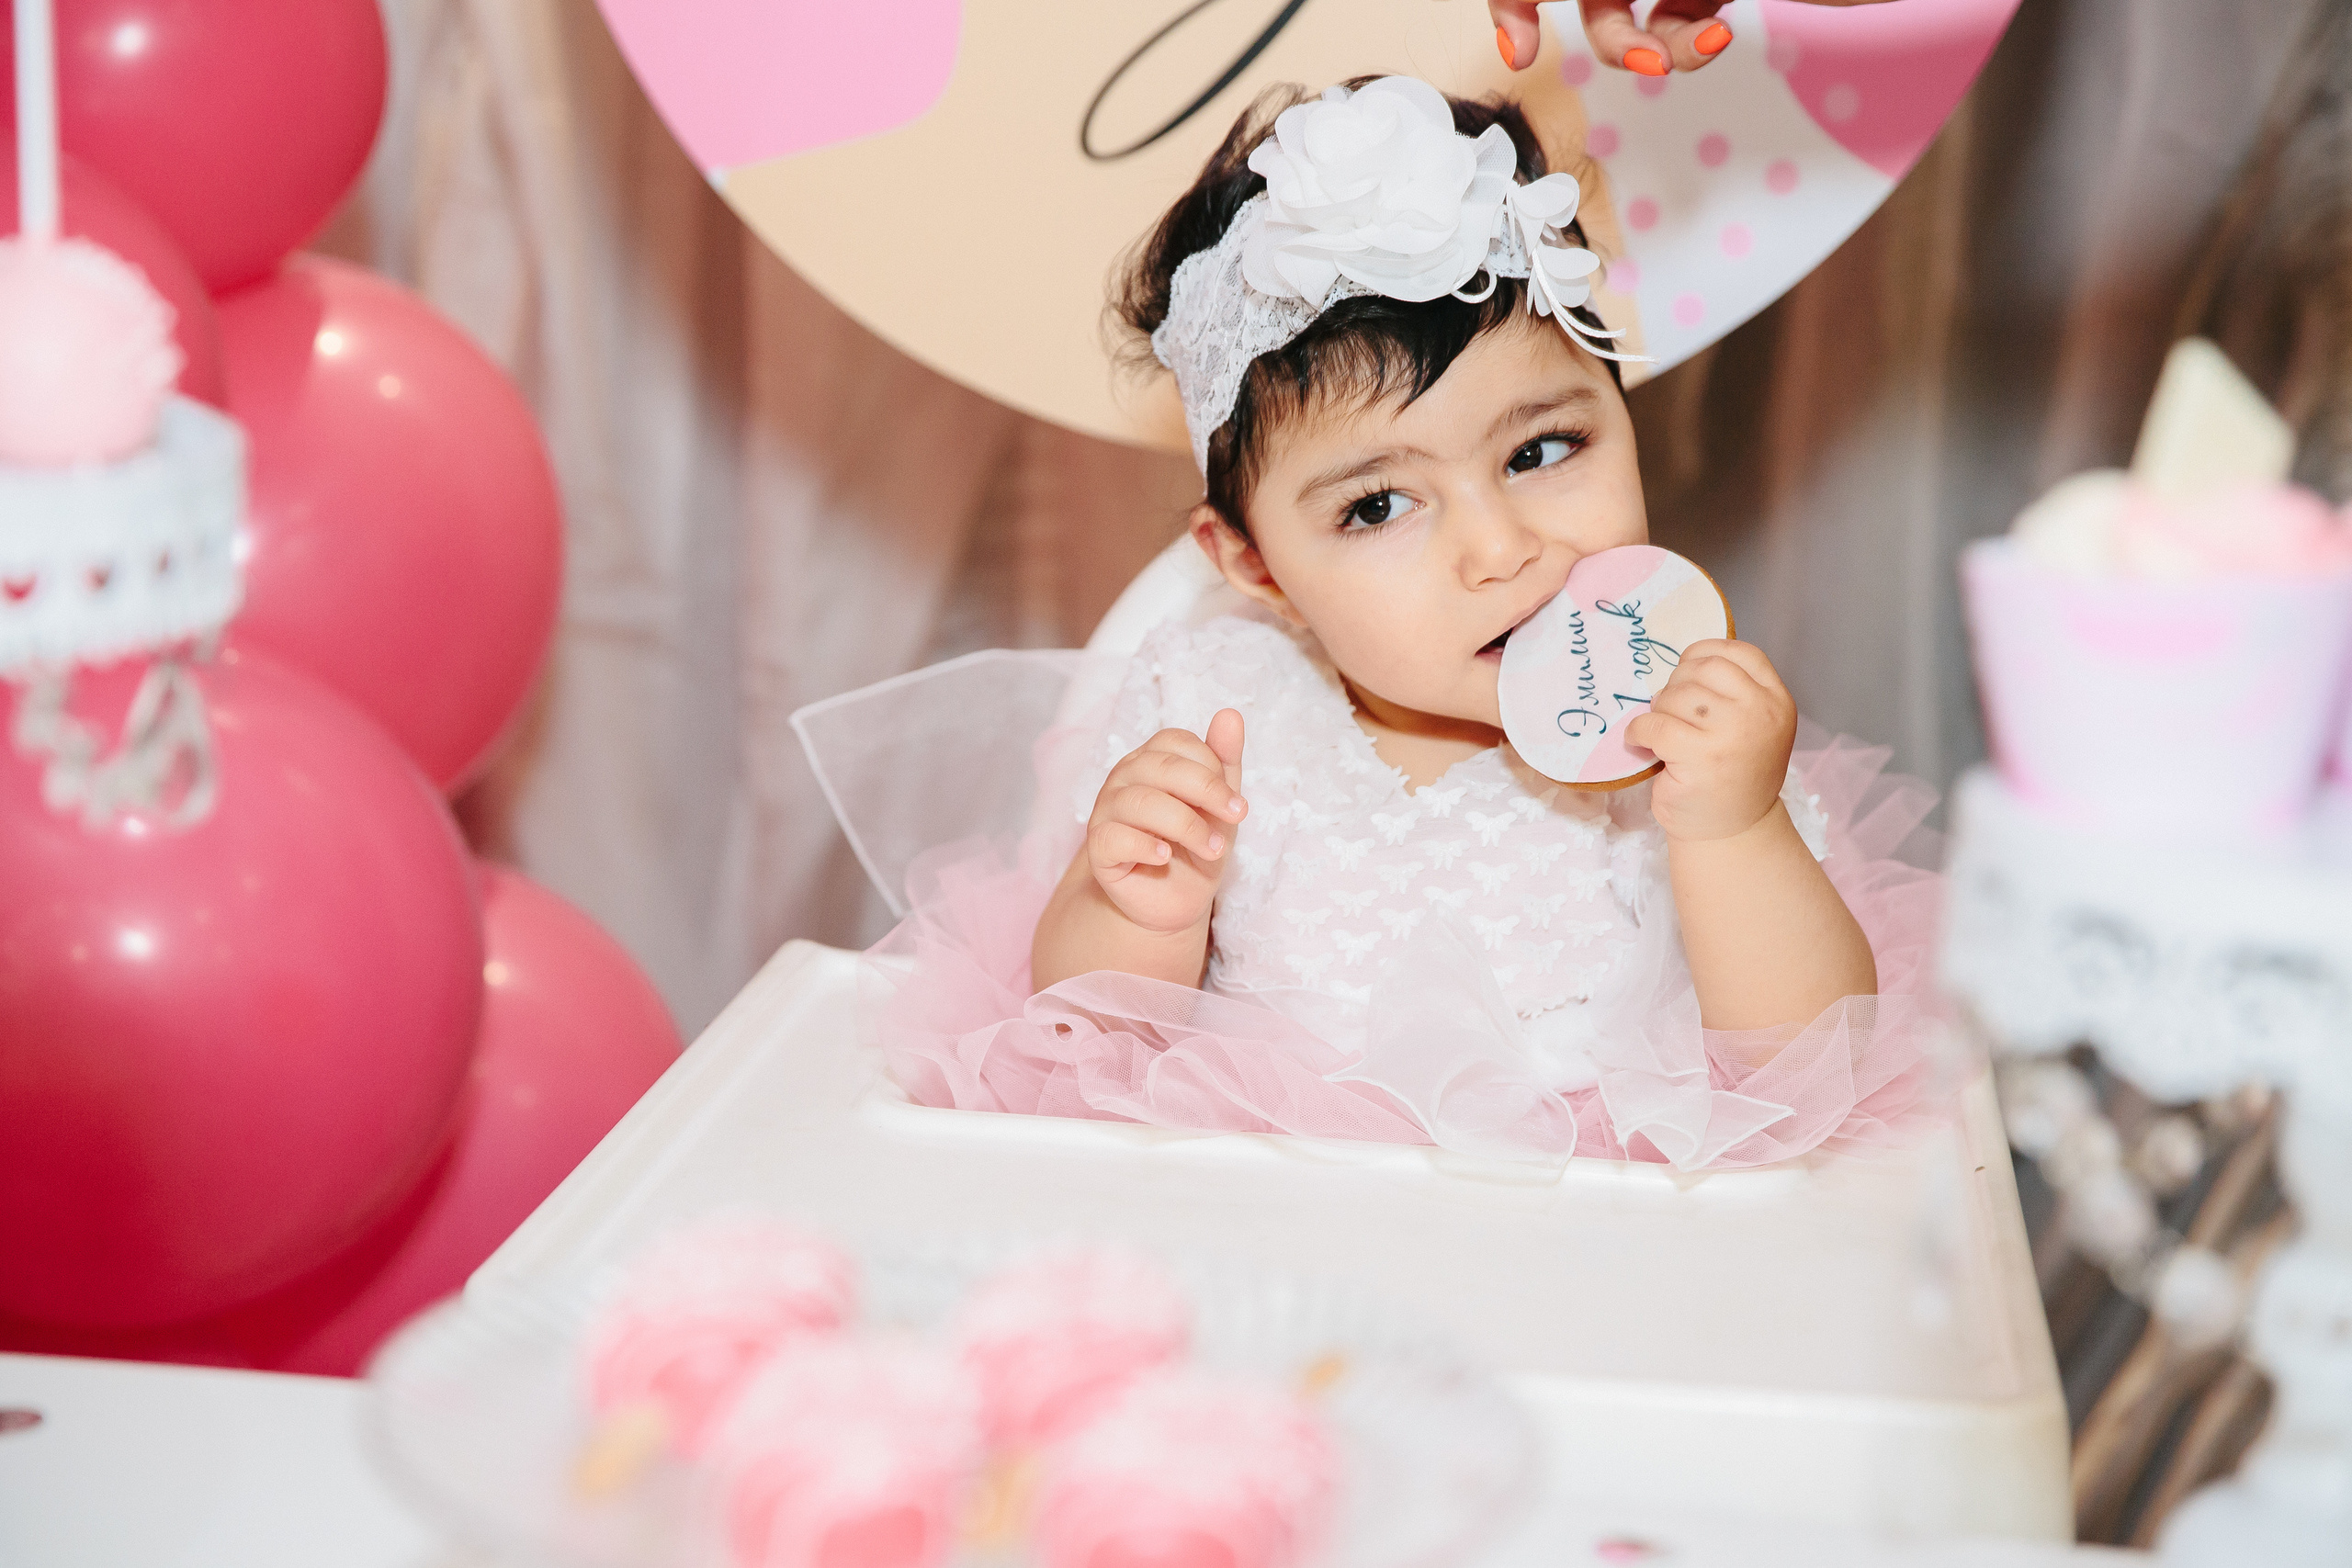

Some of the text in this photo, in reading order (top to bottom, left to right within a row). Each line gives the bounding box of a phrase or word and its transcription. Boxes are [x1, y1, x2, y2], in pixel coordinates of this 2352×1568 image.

[1556, 610, 1607, 737] Эмилии
[1595, 599, 1681, 710] 1 годик
